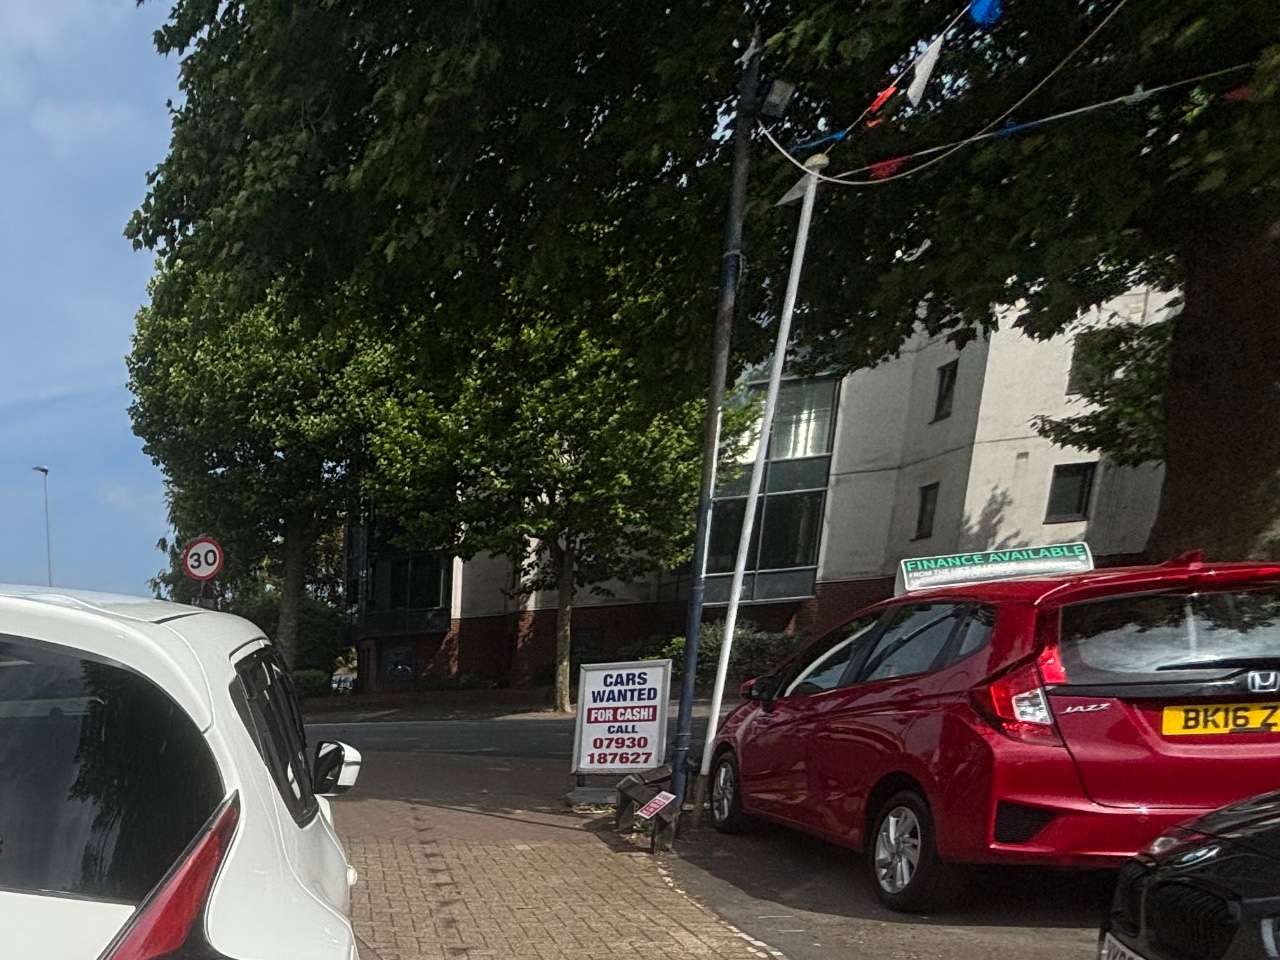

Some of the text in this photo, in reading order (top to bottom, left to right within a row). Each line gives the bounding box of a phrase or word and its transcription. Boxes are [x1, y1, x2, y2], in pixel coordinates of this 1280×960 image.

[190, 549, 217, 569] 30
[906, 554, 985, 572] FINANCE
[990, 545, 1085, 562] AVAILABLE
[603, 671, 648, 688] CARS
[592, 687, 658, 703] WANTED
[590, 707, 653, 722] FOR CASH!
[1059, 702, 1111, 714] JAZZ
[1182, 706, 1249, 729] BK16
[607, 724, 639, 735] CALL
[592, 736, 648, 749] 07930
[587, 752, 653, 764] 187627
